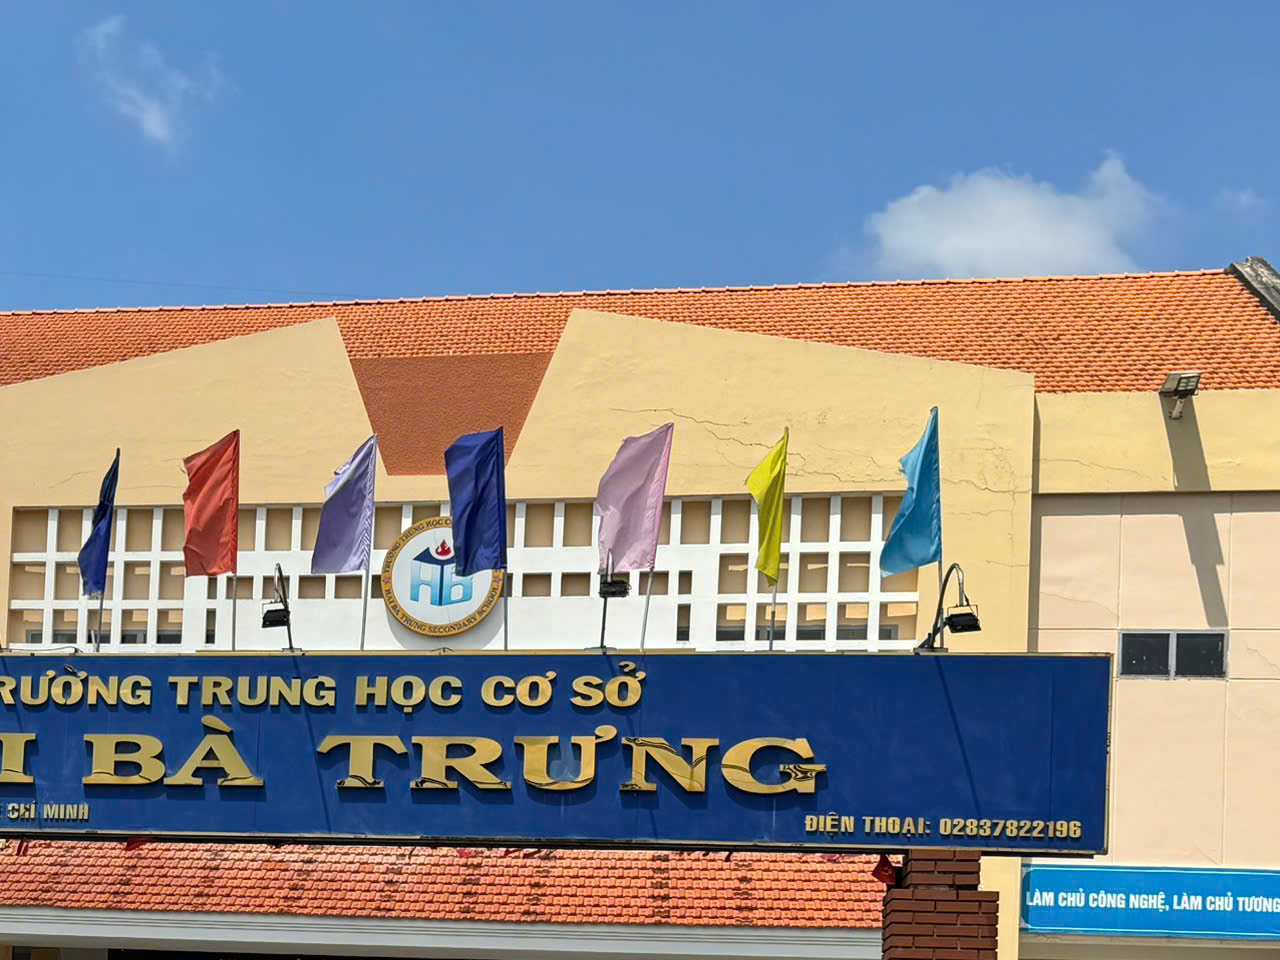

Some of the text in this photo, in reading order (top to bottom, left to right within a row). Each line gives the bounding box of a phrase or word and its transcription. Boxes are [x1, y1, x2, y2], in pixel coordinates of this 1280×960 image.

[168, 675, 337, 708] TRUNG
[354, 675, 463, 713] HỌC
[481, 670, 557, 708] CƠ
[570, 661, 647, 708] SỞ
[83, 714, 265, 787] BÀ
[317, 724, 827, 794] TRƯNG
[7, 799, 36, 820] CHÍ
[43, 801, 90, 821] MINH
[804, 811, 1082, 839] ĐIỆN THOẠI: 02837822196
[1025, 887, 1280, 913] LÀM CHỦ CÔNG NGHỆ, LÀM CHỦ TƯƠNG
